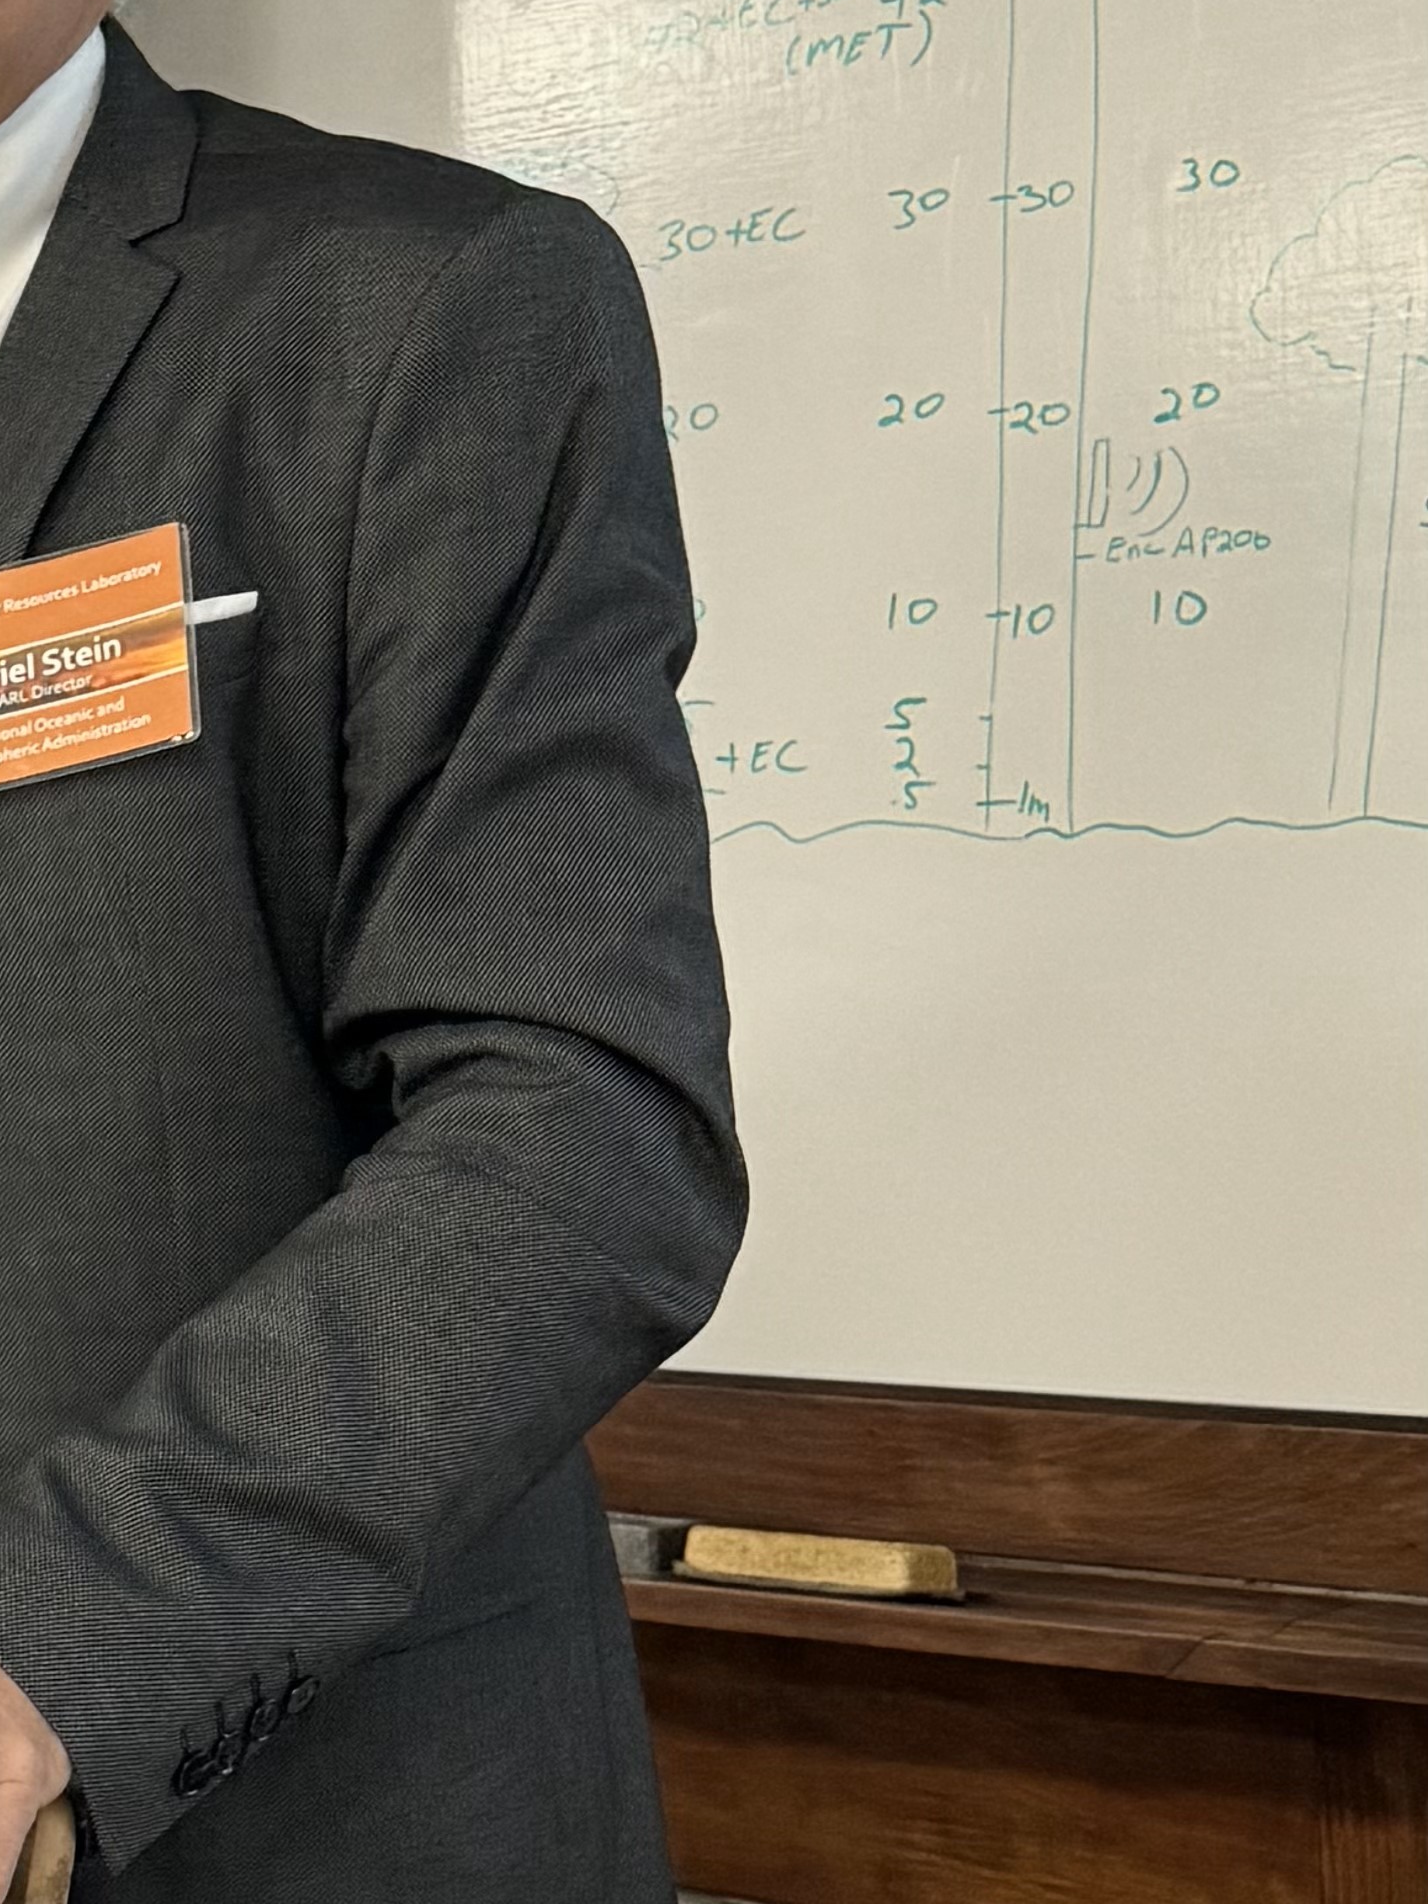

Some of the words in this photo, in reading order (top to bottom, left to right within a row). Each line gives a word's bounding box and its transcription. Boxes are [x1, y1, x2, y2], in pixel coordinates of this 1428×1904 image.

[786, 8, 932, 76] (MET)
[1177, 158, 1240, 192] 30
[888, 188, 951, 230] 30
[1017, 180, 1075, 213] 30
[878, 393, 945, 427] 20
[1010, 401, 1071, 434] 20
[1153, 383, 1220, 424] 20
[3, 584, 79, 613] Resources
[81, 561, 162, 594] Laboratory
[888, 592, 938, 630] 10
[1012, 603, 1055, 639] 10
[1153, 590, 1208, 626] 10
[42, 636, 122, 676] Stein
[31, 674, 93, 700] Director
[34, 707, 95, 734] Oceanic
[97, 696, 125, 716] and
[42, 713, 152, 751] Administration
[885, 697, 928, 730] 5
[894, 736, 920, 777] 2
